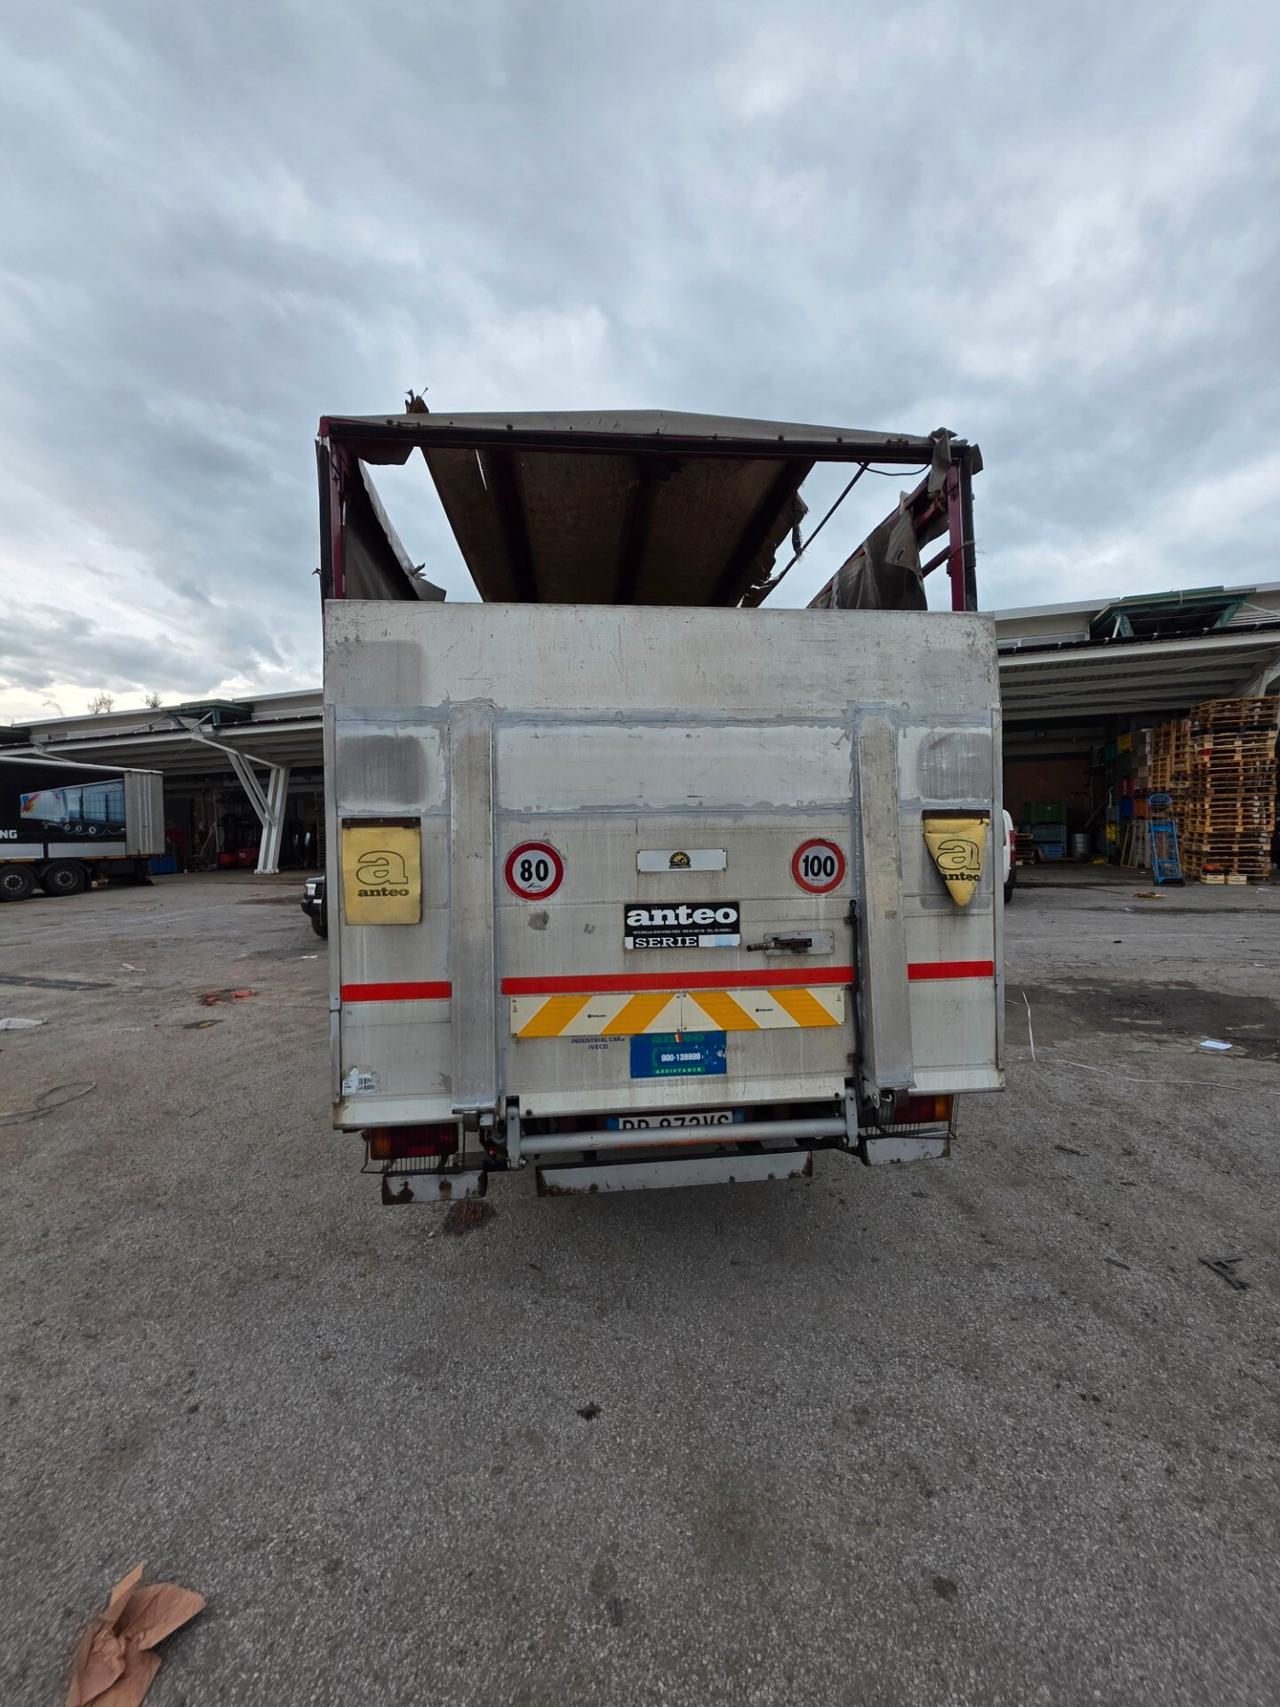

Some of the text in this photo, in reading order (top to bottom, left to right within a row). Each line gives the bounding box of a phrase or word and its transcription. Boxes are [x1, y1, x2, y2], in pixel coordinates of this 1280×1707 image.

[520, 859, 549, 882] 80
[802, 854, 835, 877] 100
[357, 888, 410, 897] anteo
[626, 905, 738, 926] anteo
[635, 936, 698, 948] SERIE
